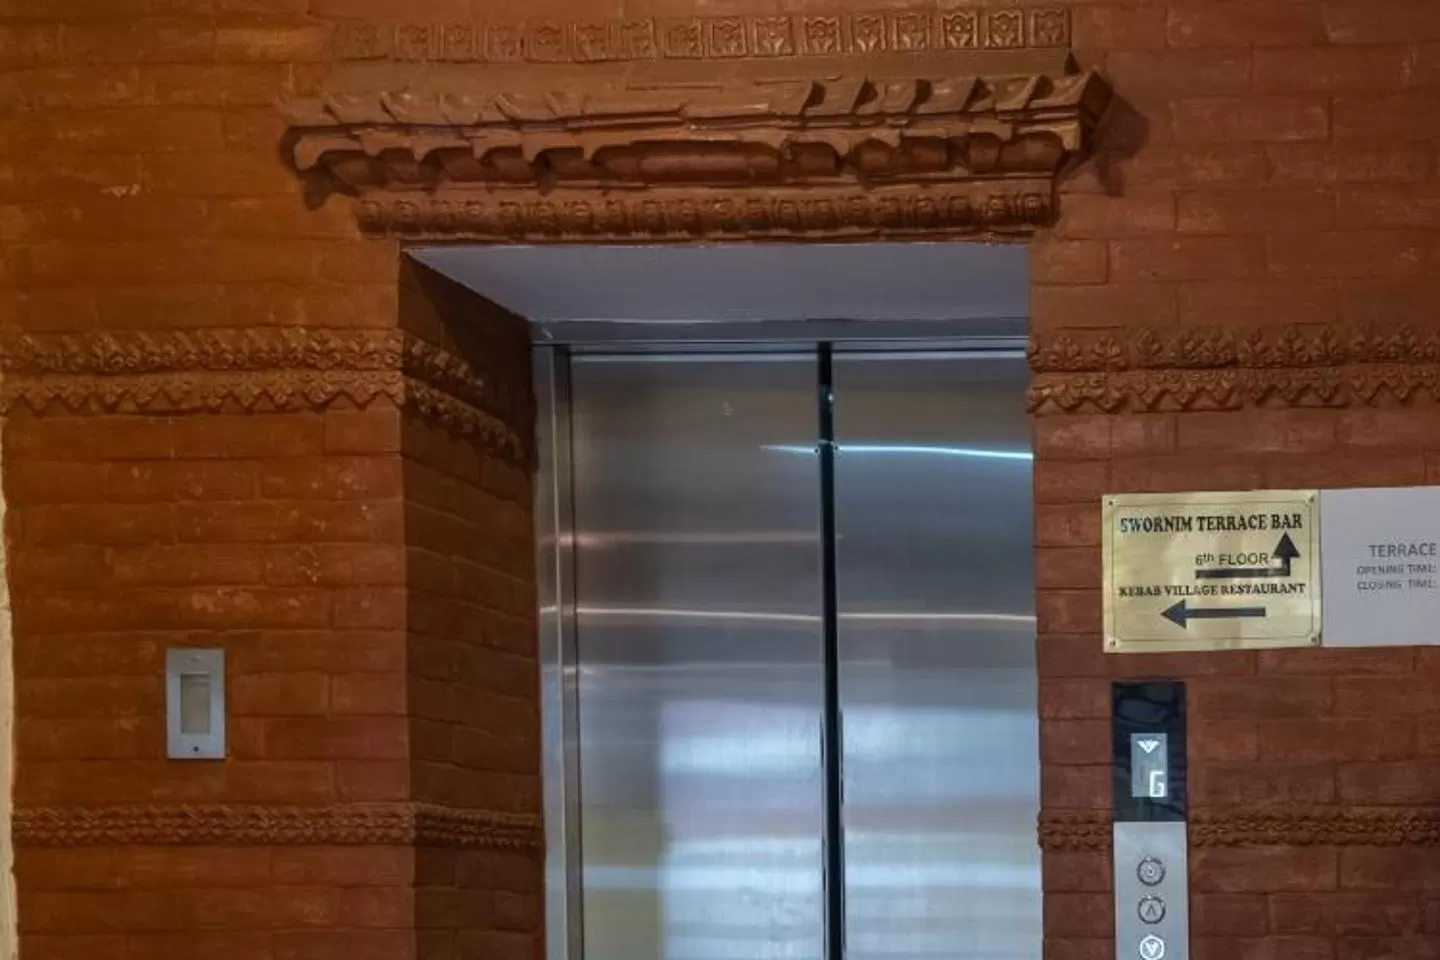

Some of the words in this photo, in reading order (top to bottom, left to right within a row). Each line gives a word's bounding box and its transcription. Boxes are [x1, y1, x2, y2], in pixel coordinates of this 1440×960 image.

[1120, 515, 1192, 532] SWORNIM
[1197, 514, 1268, 531] TERRACE
[1271, 513, 1302, 529] BAR
[1368, 542, 1437, 558] TERRACE
[1218, 552, 1268, 565] FLOOR
[1118, 585, 1162, 597] KEBAB
[1164, 584, 1218, 596] VILLAGE
[1220, 583, 1306, 595] RESTAURANT
